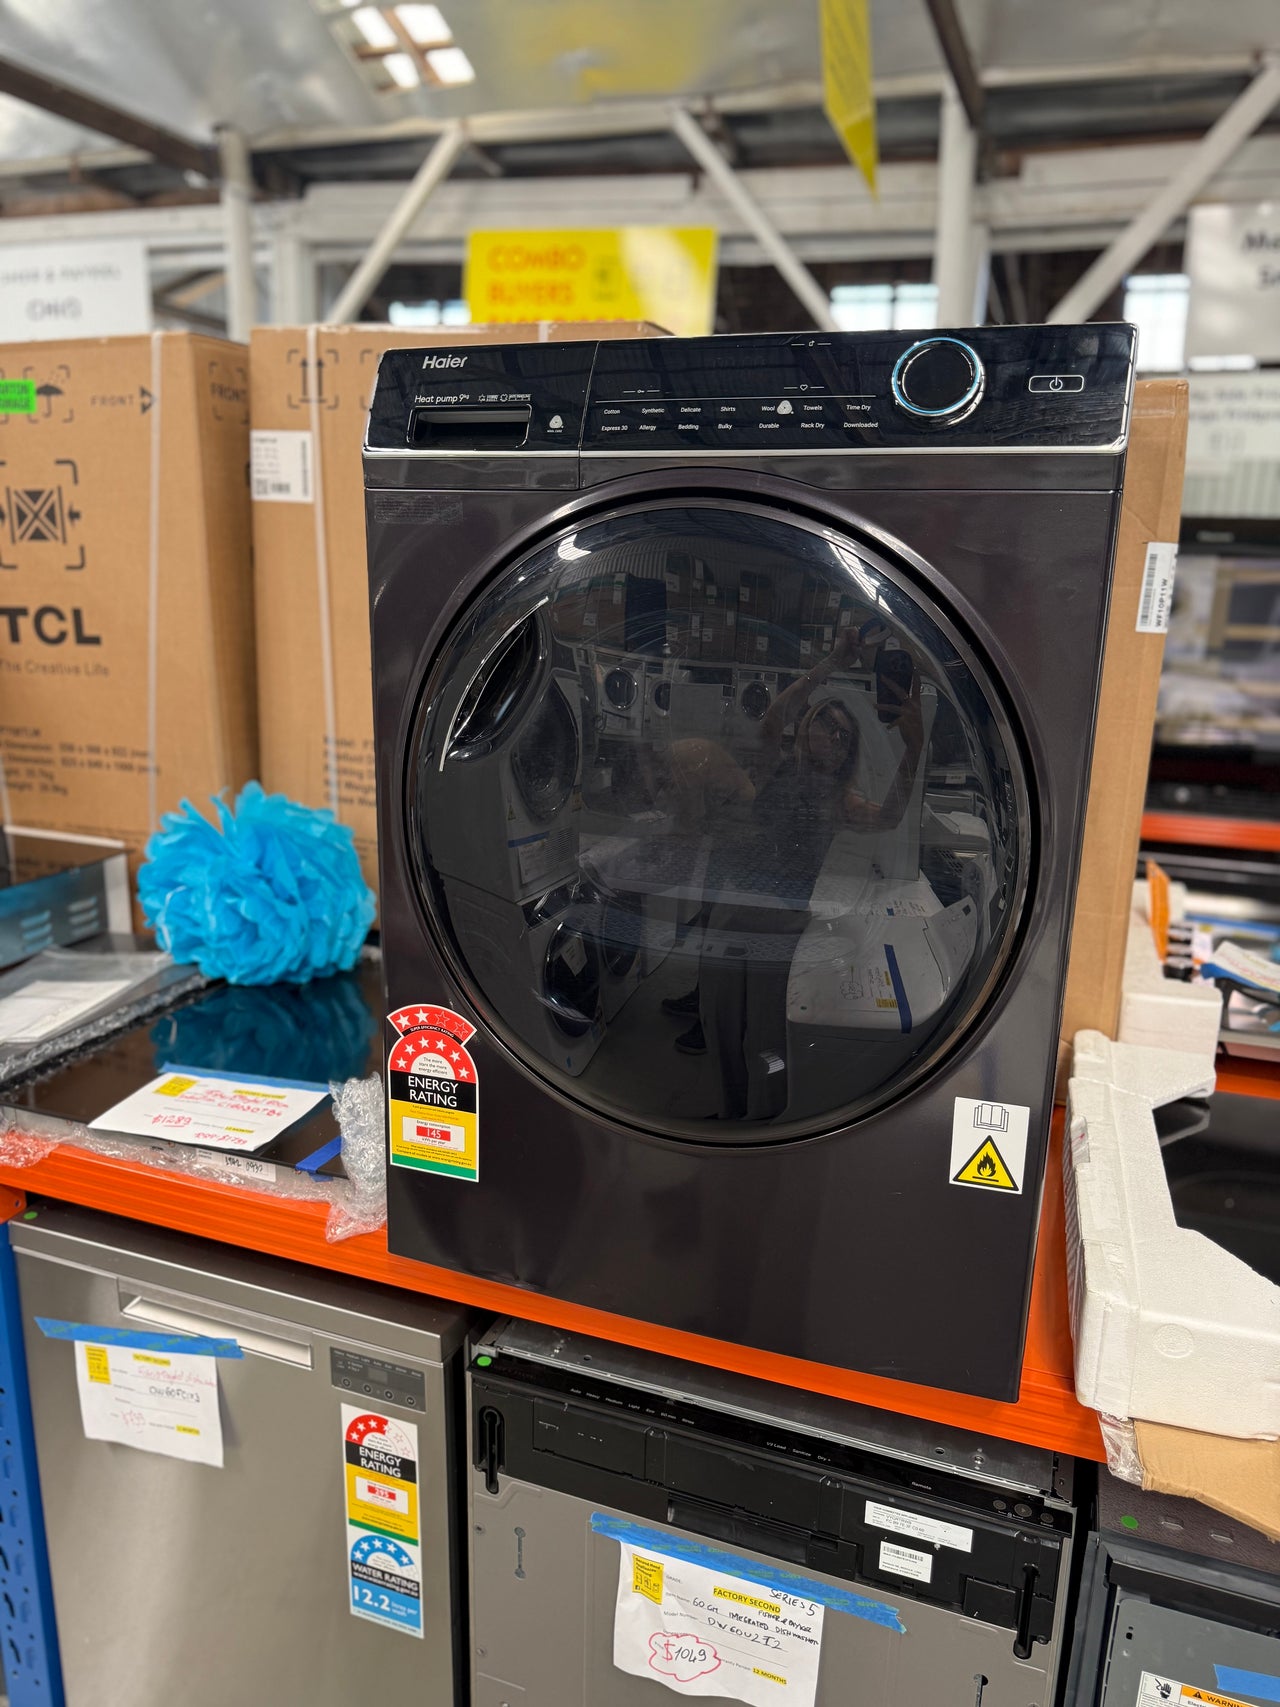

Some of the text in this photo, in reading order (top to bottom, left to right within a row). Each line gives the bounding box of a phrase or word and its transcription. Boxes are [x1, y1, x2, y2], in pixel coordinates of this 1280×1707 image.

[421, 354, 468, 369] Haier
[90, 395, 134, 406] FRONT
[414, 395, 435, 403] Heat
[435, 396, 458, 404] pump
[0, 605, 102, 645] TCL
[24, 660, 80, 675] Creative
[407, 1075, 459, 1094] ENERGY
[409, 1090, 457, 1108] RATING
[151, 1114, 192, 1125] $1289
[427, 1128, 442, 1139] 145
[605, 1397, 623, 1405] Medium
[359, 1446, 402, 1467] ENERGY
[360, 1457, 402, 1478] RATING
[911, 1481, 932, 1490] Remote
[352, 1562, 383, 1580] WATER
[384, 1573, 418, 1591] RATING
[353, 1585, 391, 1612] 12.2
[692, 1597, 705, 1608] 60
[713, 1587, 781, 1614] FACTORY SECOND
[769, 1588, 820, 1617] SERIES 5
[662, 1639, 707, 1664] $1049
[760, 1669, 787, 1684] MONTHS
